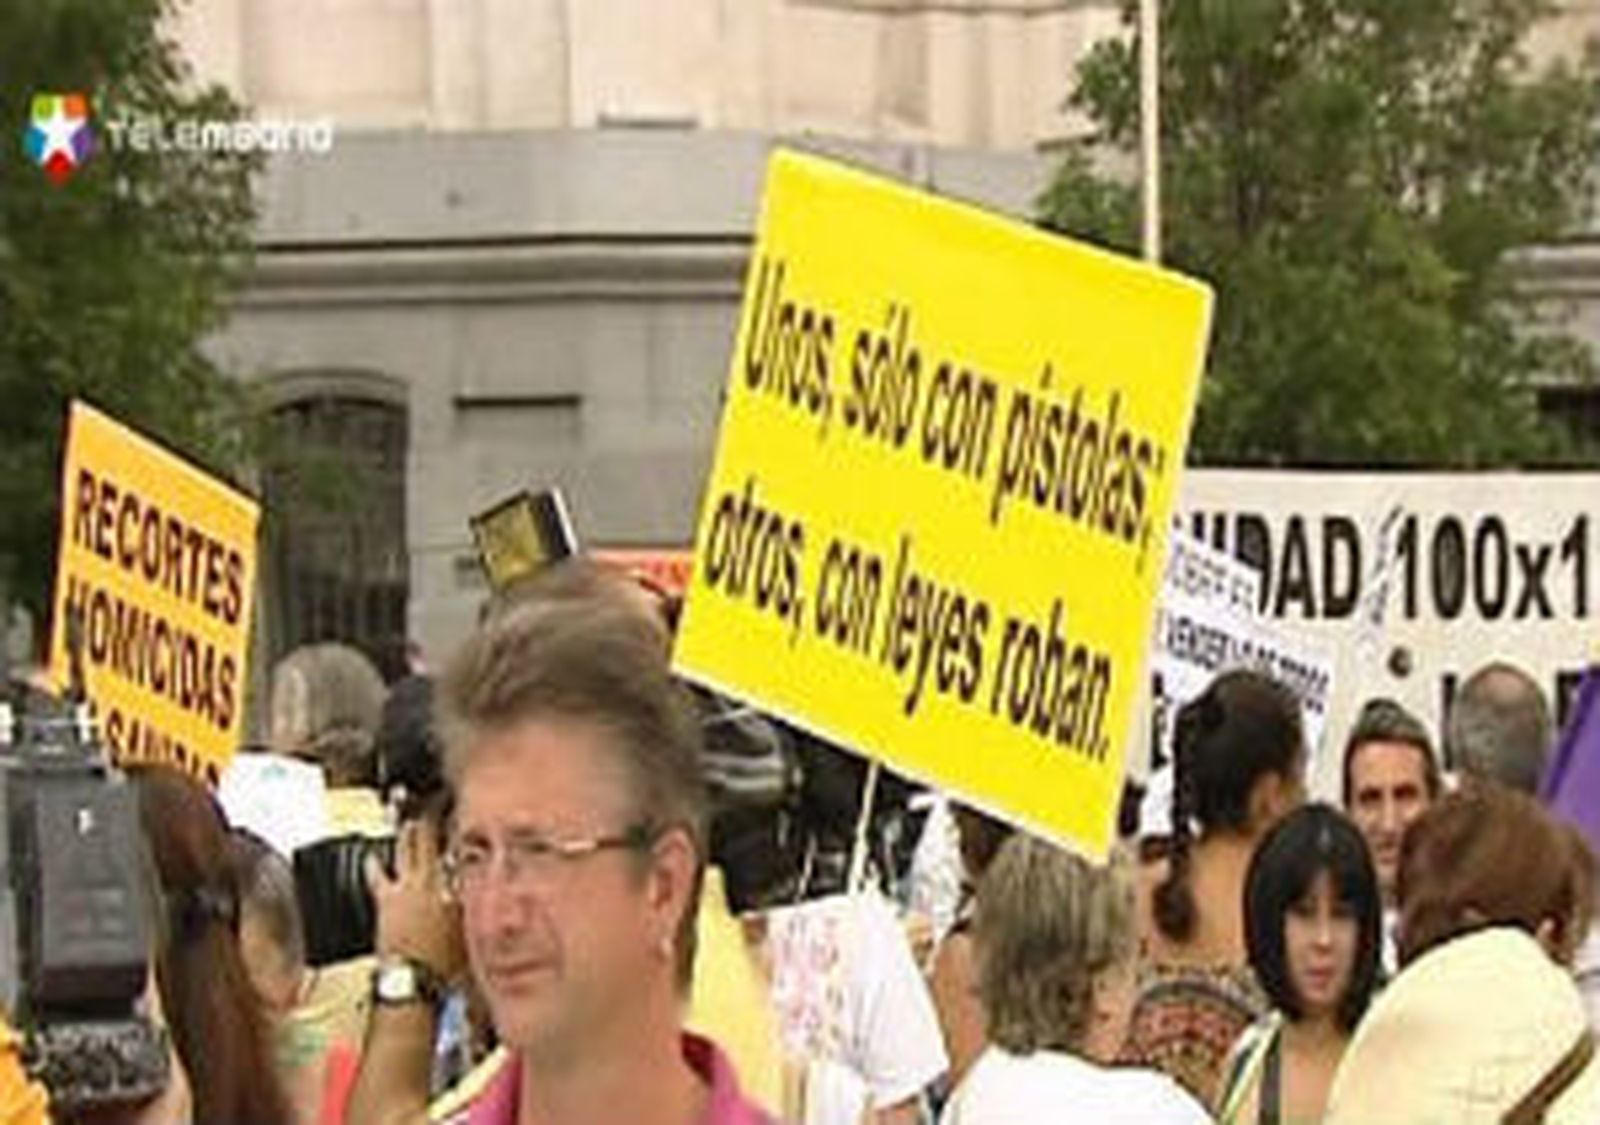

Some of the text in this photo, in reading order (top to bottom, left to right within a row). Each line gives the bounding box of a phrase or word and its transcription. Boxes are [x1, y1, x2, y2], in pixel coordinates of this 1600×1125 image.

[744, 258, 1164, 574] Unos, sólo con pistolas;
[74, 470, 245, 626] RECORTES
[705, 475, 805, 647] otros,
[814, 539, 881, 654] con
[881, 532, 991, 716] leyes
[990, 598, 1112, 762] roban.
[1397, 515, 1588, 620] 100x1
